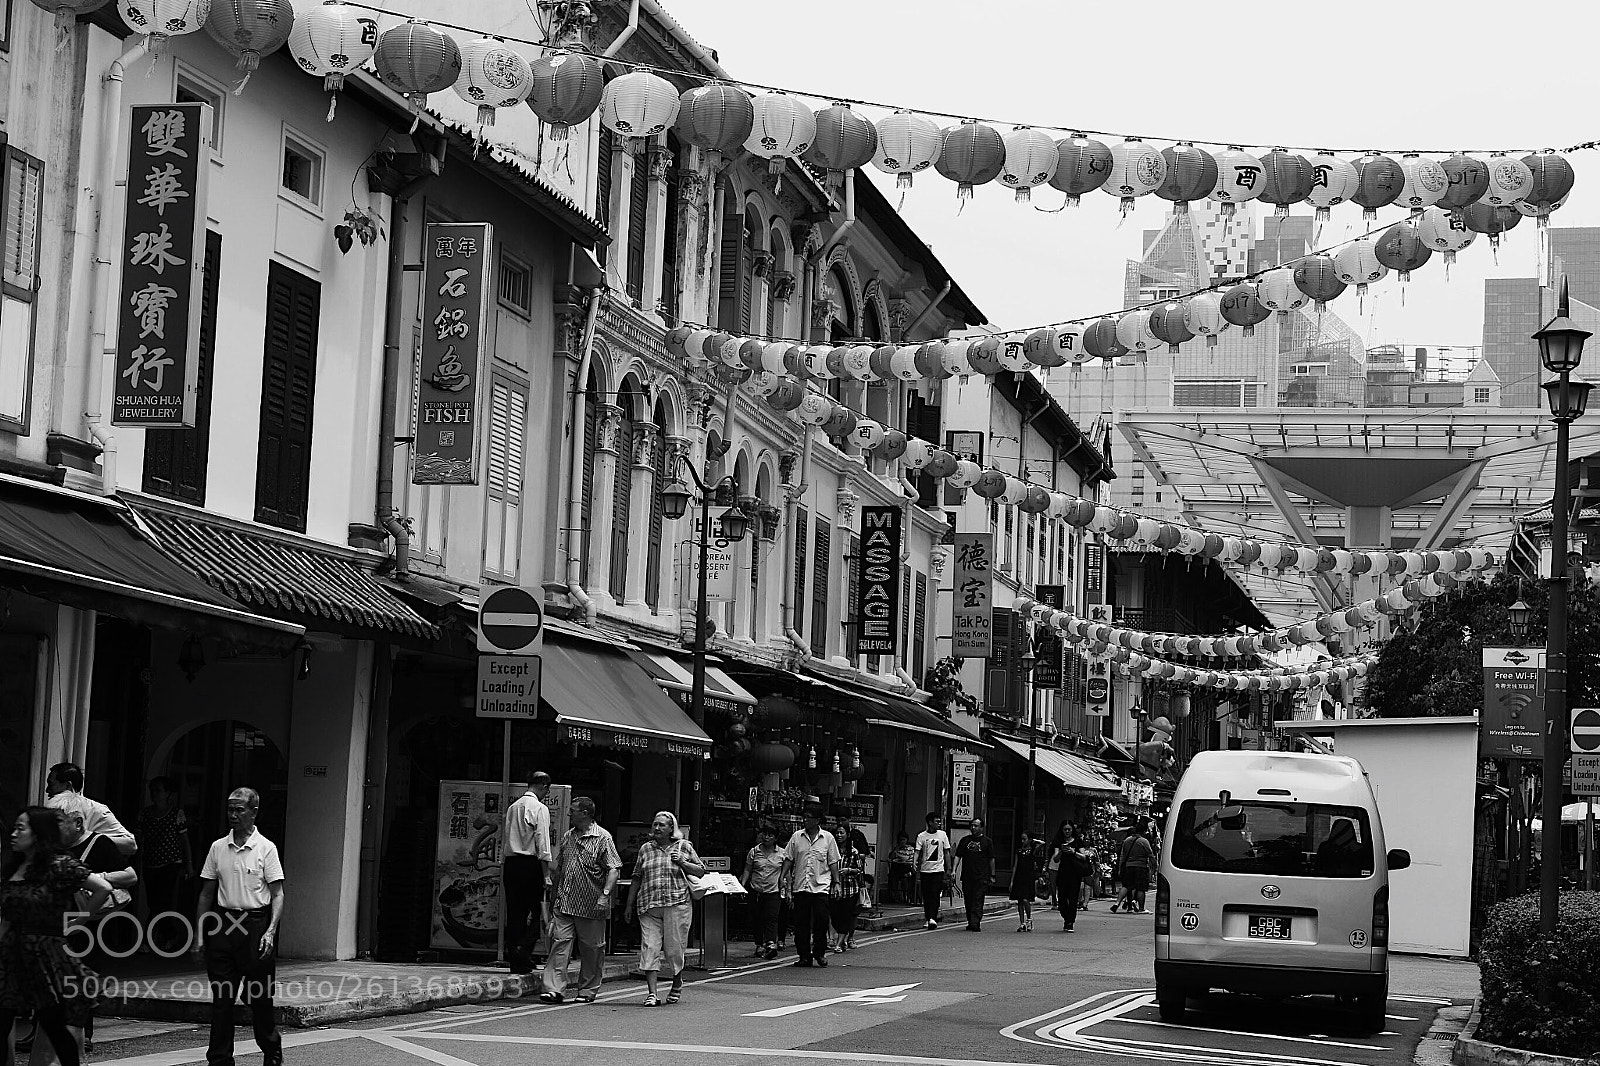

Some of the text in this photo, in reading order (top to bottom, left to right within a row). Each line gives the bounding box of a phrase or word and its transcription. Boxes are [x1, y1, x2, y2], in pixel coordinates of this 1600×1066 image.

[122, 109, 190, 392] 雙華珠寶行
[435, 236, 477, 258] 萬年
[432, 267, 471, 392] 石鍋魚
[115, 395, 182, 405] SHUANG HUA
[119, 408, 178, 418] JEWELLERY
[424, 408, 471, 423] FISH
[697, 571, 719, 579] CFÉ
[863, 511, 892, 637] MASSAGE
[957, 539, 989, 608] 德宝
[955, 616, 989, 628] Tak Po
[955, 630, 988, 639] Hong Kong
[490, 661, 529, 678] Except
[1494, 671, 1537, 680] Free Wi-Fi
[482, 680, 535, 697] Loading /
[481, 699, 535, 717] Unloading
[1547, 719, 1554, 735] 7
[1578, 758, 1600, 768] Except
[1574, 770, 1597, 781] Loading
[957, 776, 971, 807] 点心
[1574, 782, 1600, 792] Unloadin
[703, 859, 727, 867] NETS
[1183, 915, 1196, 925] 70
[1258, 918, 1282, 928] GBC
[1250, 926, 1290, 938] 5925J
[1352, 931, 1366, 941] 13
